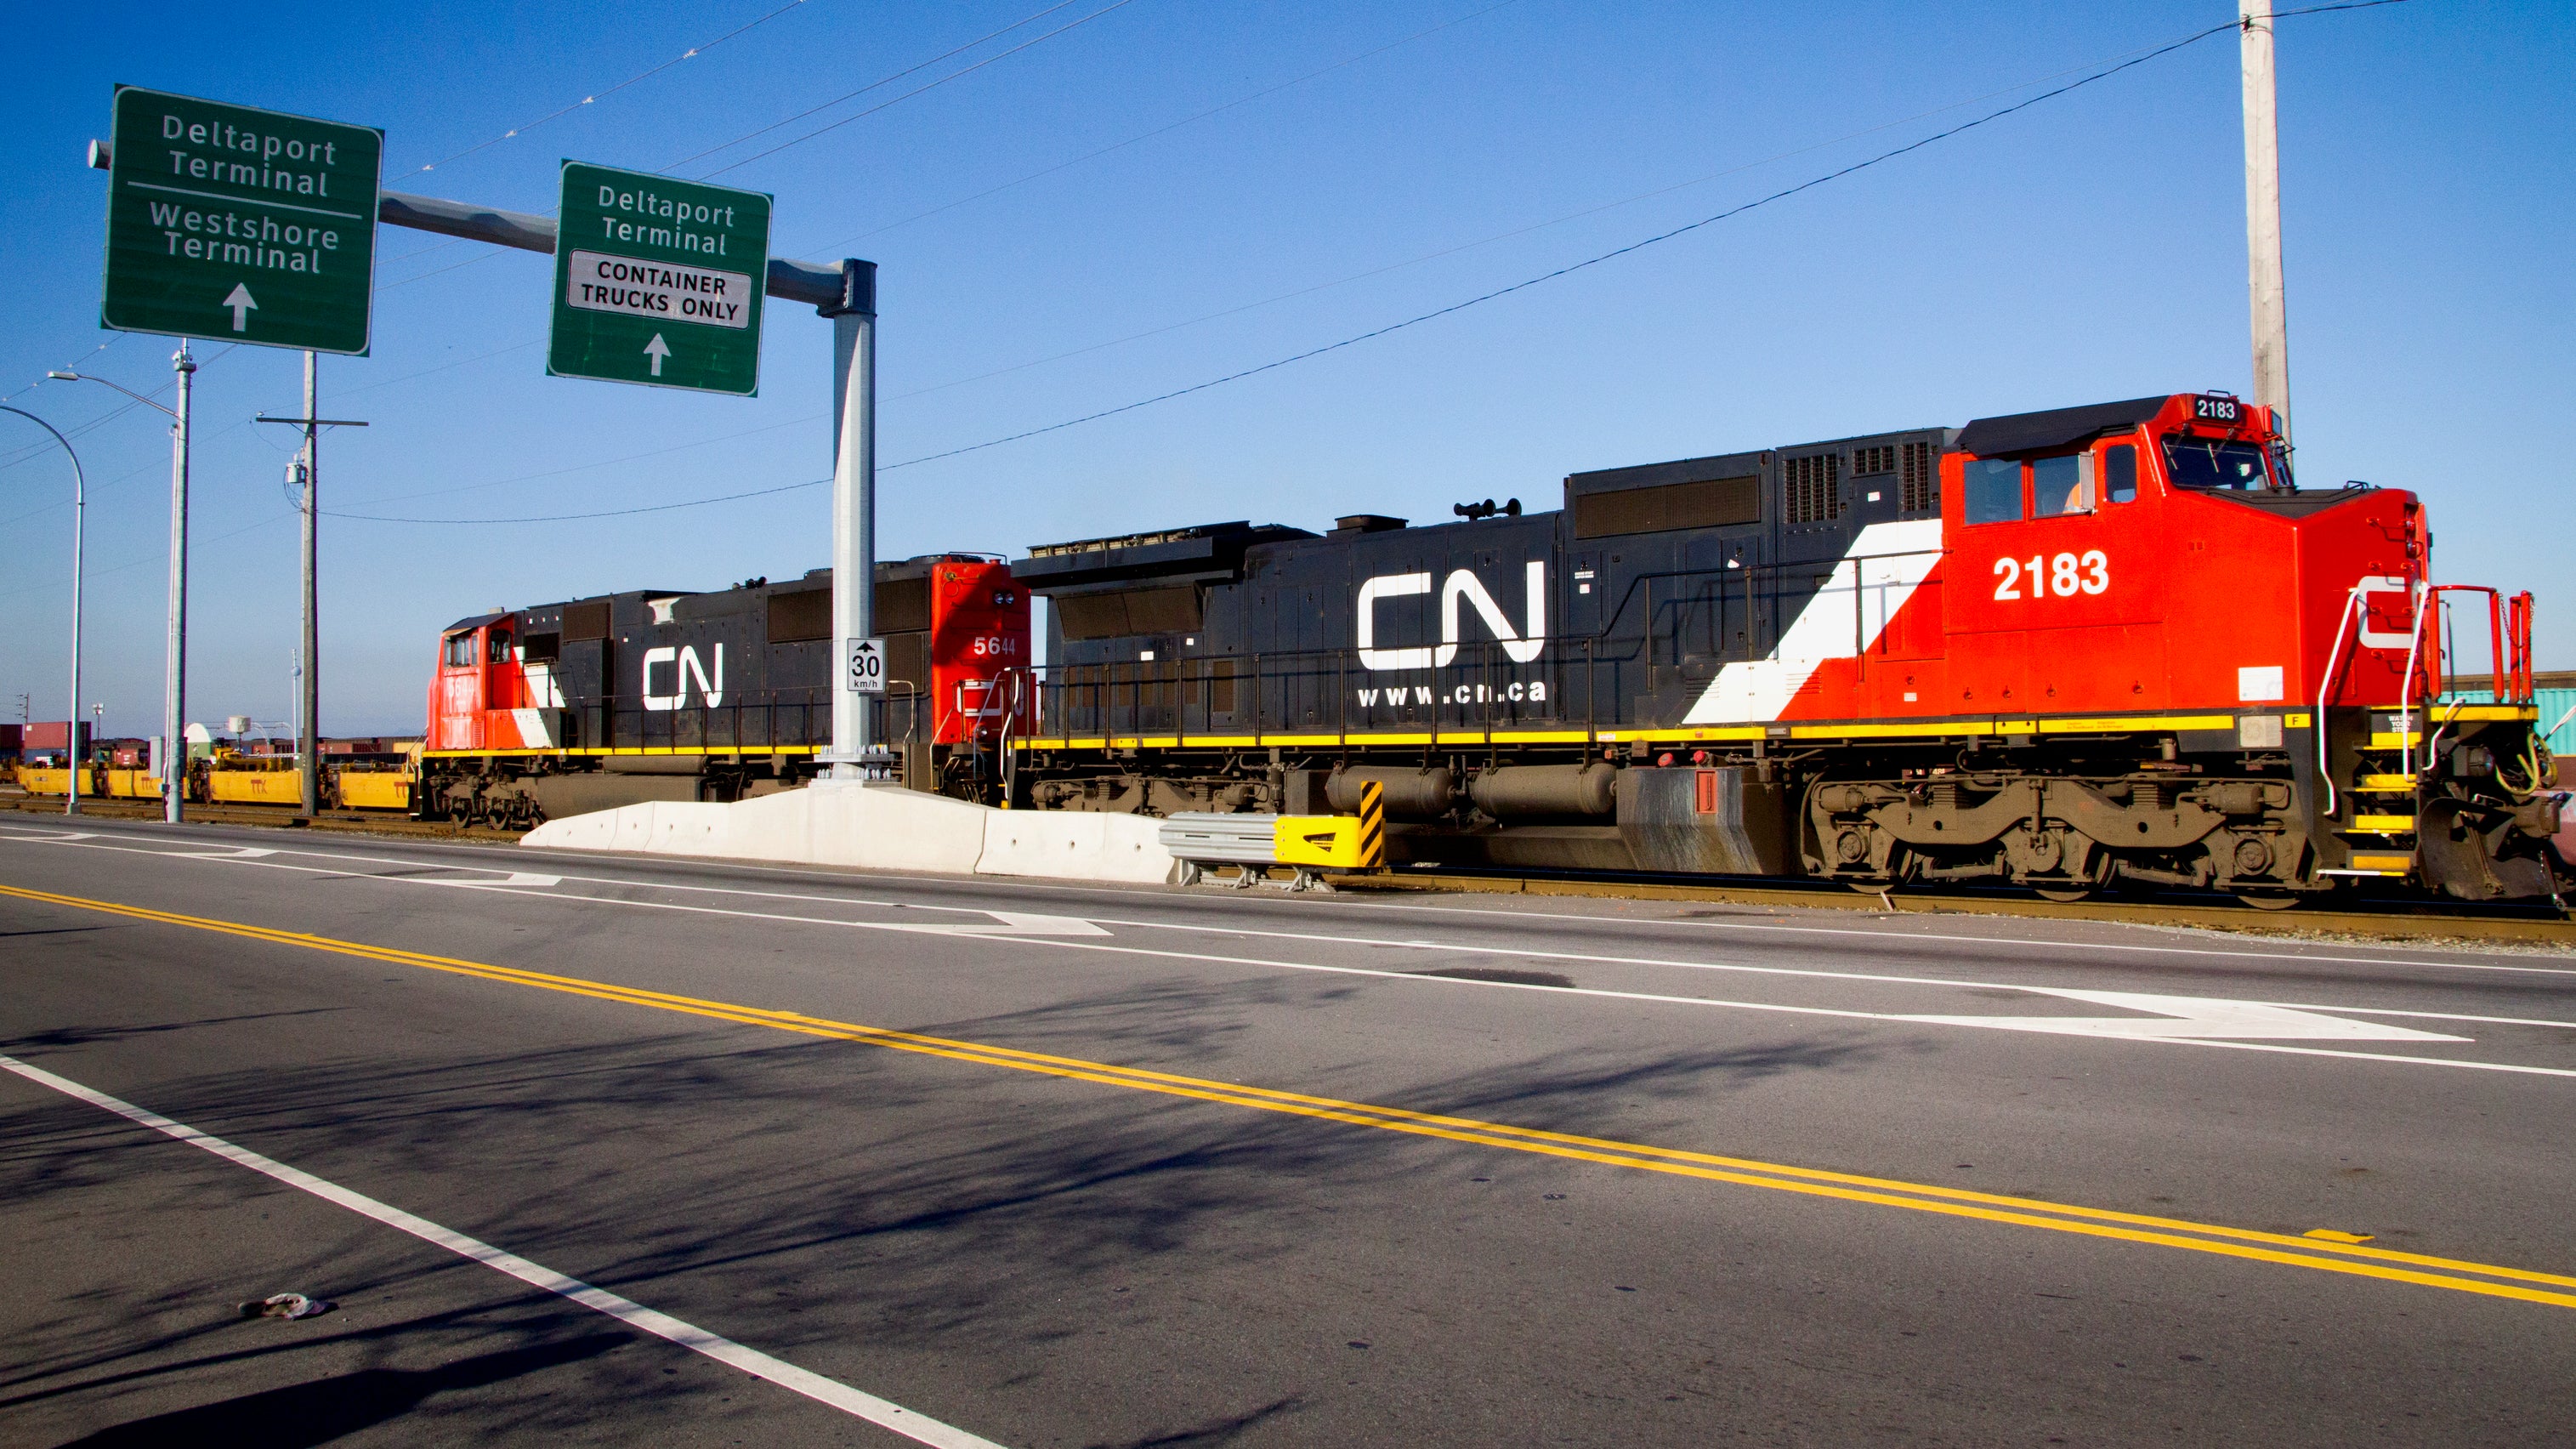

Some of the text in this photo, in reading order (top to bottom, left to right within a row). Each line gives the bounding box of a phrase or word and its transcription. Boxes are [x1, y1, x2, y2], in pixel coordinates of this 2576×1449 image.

[162, 115, 337, 166] Deltaport
[169, 150, 327, 197] Terminal
[150, 201, 339, 250] Westshore
[599, 185, 735, 228] Deltaport
[164, 230, 321, 274] Terminal
[602, 216, 726, 256] Terminal
[598, 260, 726, 296] CONTAINER
[582, 283, 739, 321] TRUCKS ONLY
[2197, 399, 2235, 419] 2183
[1994, 549, 2110, 601] 2183
[1358, 560, 1546, 672] CN
[973, 636, 1016, 656] 5644
[643, 642, 723, 711] CN
[852, 655, 880, 678] 30
[854, 679, 877, 688] km/h
[448, 677, 474, 697] 5644
[1358, 681, 1546, 707] www.cn.ca
[2292, 717, 2299, 725] F
